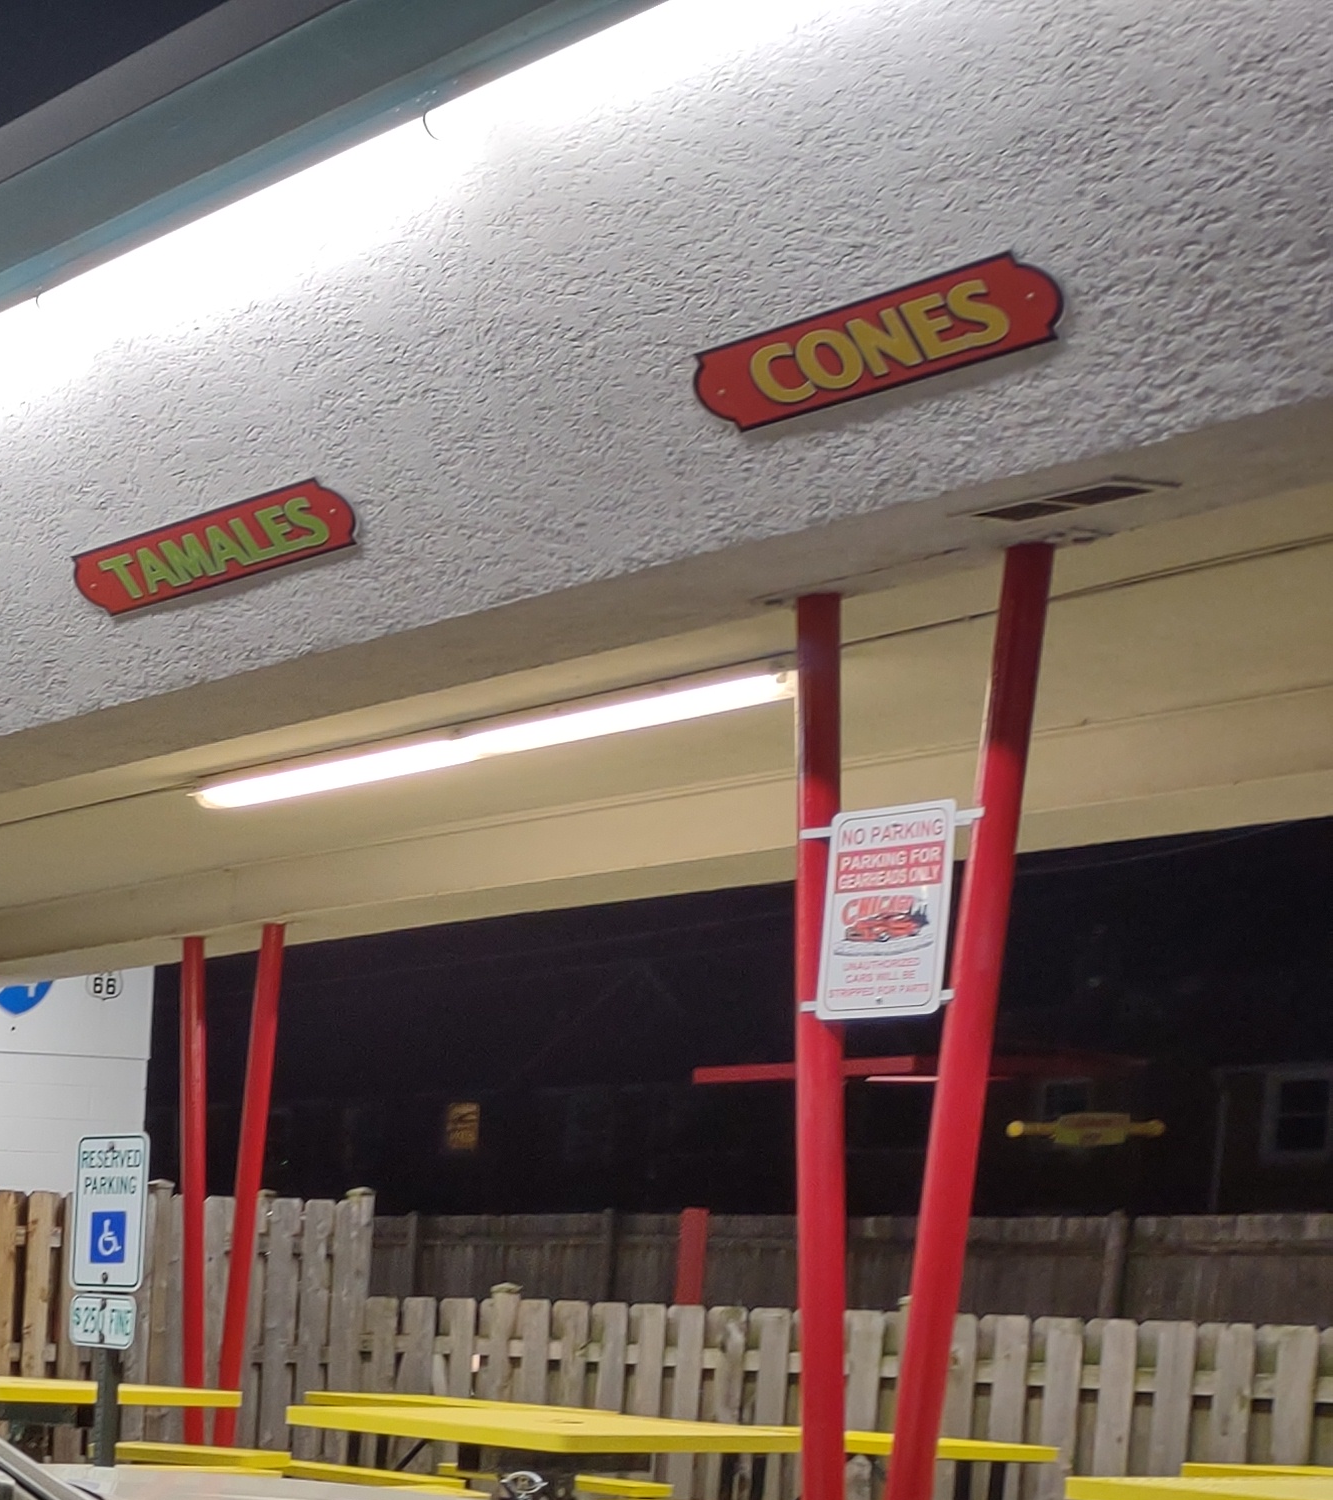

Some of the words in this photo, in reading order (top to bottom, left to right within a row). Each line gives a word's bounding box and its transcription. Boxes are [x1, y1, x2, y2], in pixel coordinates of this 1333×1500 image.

[750, 279, 1010, 403] CONES
[98, 497, 329, 599] TAMALES
[842, 827, 864, 846] NO
[871, 818, 944, 843] PARKING
[840, 851, 907, 871] PARKING
[909, 846, 941, 863] FOR
[838, 868, 906, 890] GEARHEADS
[908, 864, 941, 882] ONLY
[842, 957, 921, 971] UNAUTHORIZED
[93, 977, 116, 994] 66
[845, 972, 873, 983] CARS
[876, 971, 899, 981] WILL
[902, 970, 916, 980] BE
[829, 986, 874, 998] STRIPPED
[877, 985, 897, 996] FOR
[900, 983, 929, 993] PARTS
[81, 1149, 141, 1168] RESERVED
[84, 1175, 137, 1194] PARKING
[73, 1306, 104, 1334] $250
[109, 1307, 133, 1336] FINE
